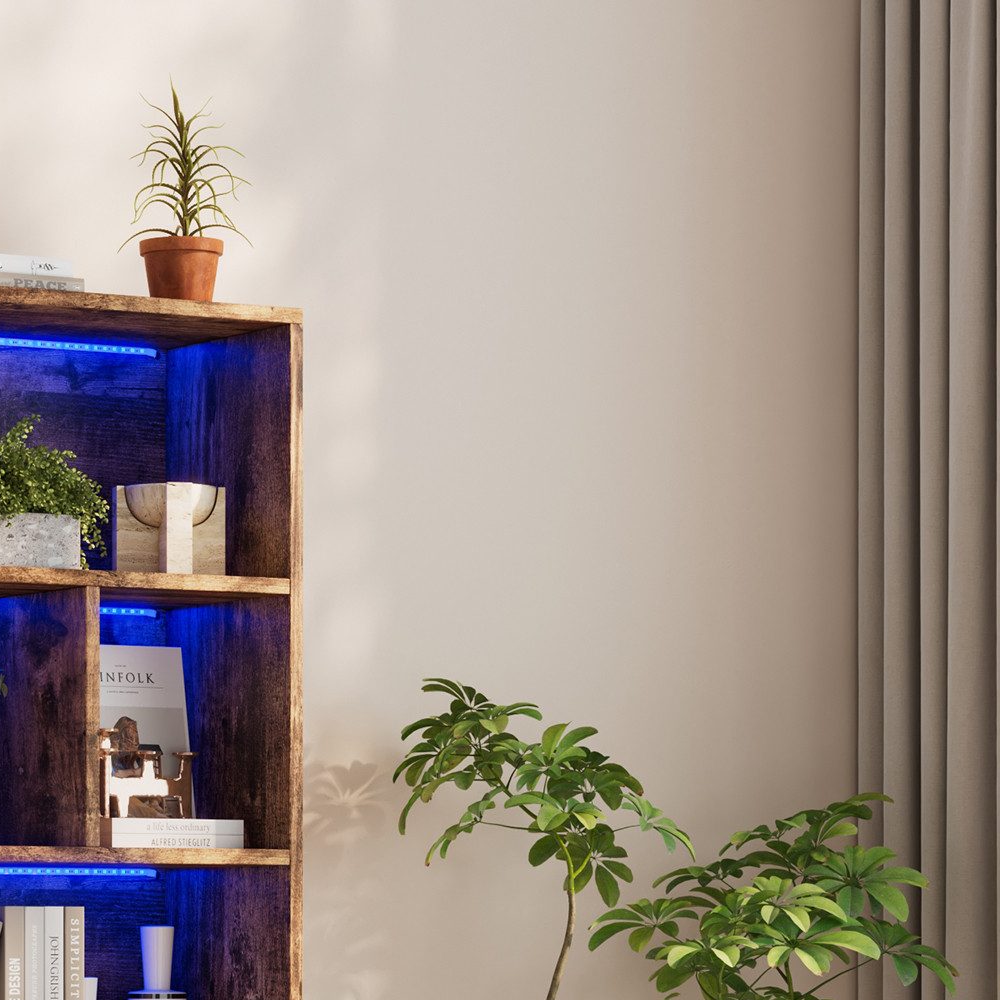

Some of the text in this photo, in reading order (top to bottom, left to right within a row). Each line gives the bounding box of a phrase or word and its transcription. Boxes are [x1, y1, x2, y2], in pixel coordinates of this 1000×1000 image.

[13, 278, 67, 290] PEACE
[100, 671, 155, 684] INFOLK
[151, 838, 211, 848] ALFRED STIEGLITZ
[49, 936, 59, 965] JOHN
[8, 957, 21, 995] DESIGN
